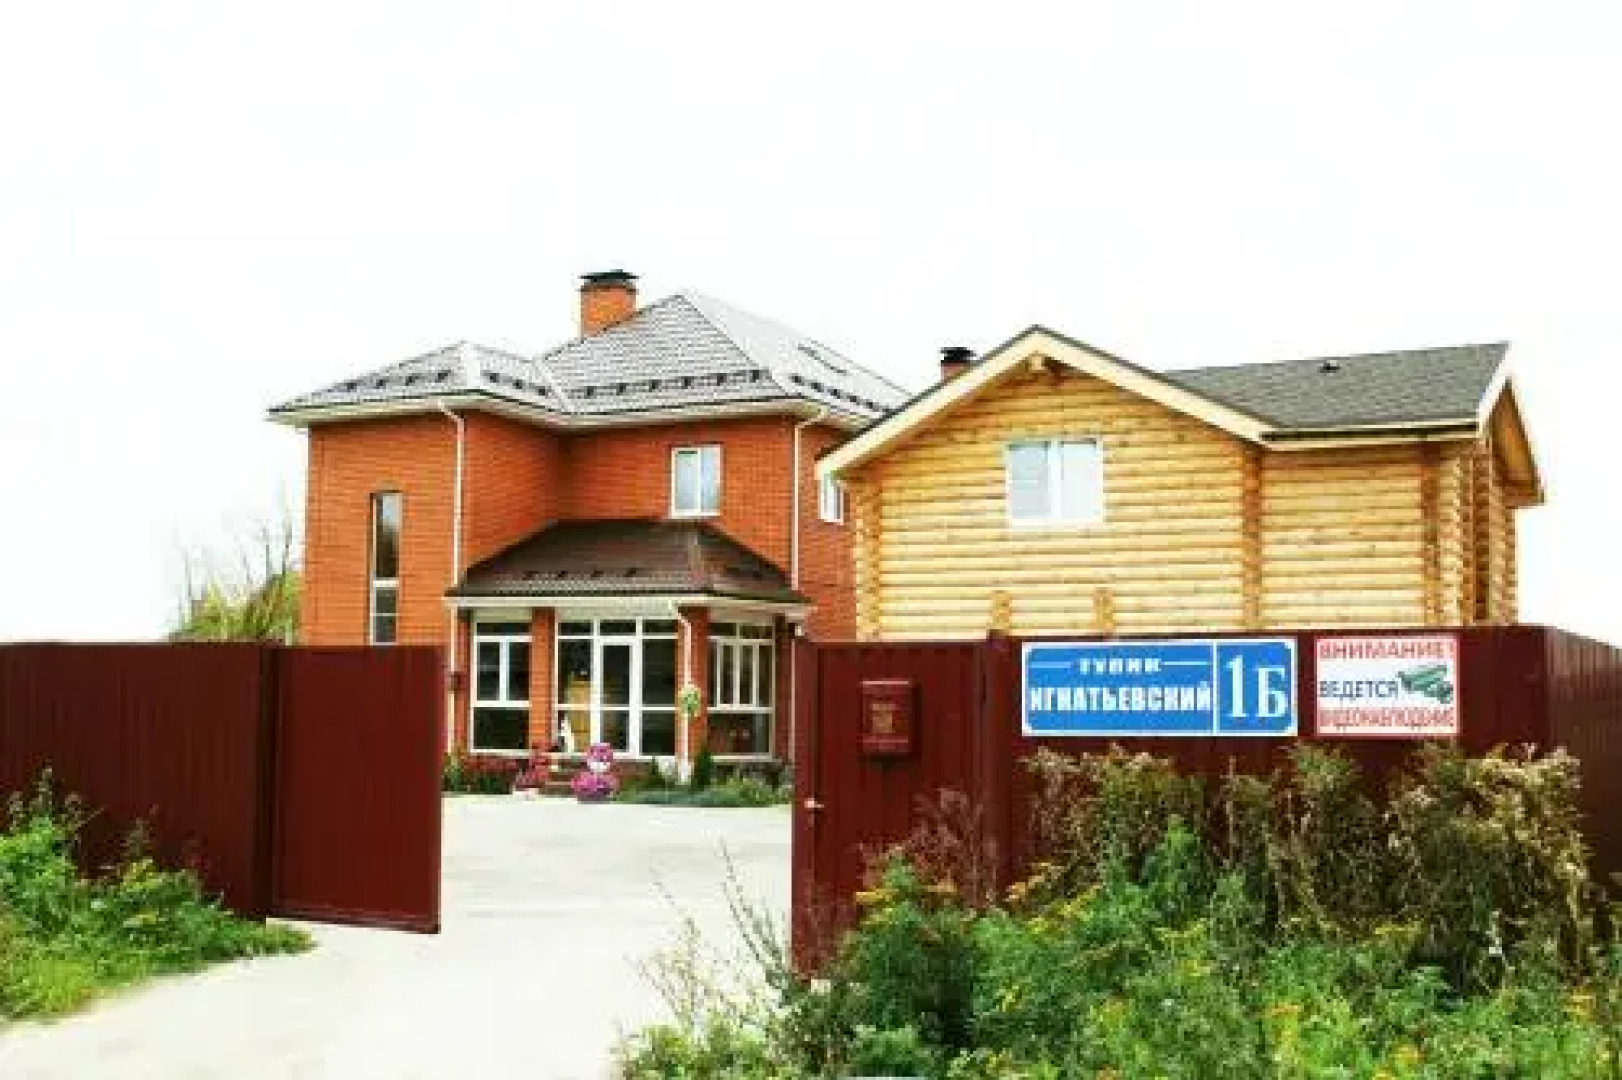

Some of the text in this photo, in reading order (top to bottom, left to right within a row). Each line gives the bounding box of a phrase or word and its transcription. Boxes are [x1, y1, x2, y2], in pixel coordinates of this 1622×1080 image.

[1079, 657, 1162, 675] ТУПИК
[1030, 682, 1211, 711] ИГНАТЬЕВСКИЙ
[1226, 655, 1289, 718] 1Б
[1319, 680, 1399, 699] ВЕДЕТСЯ
